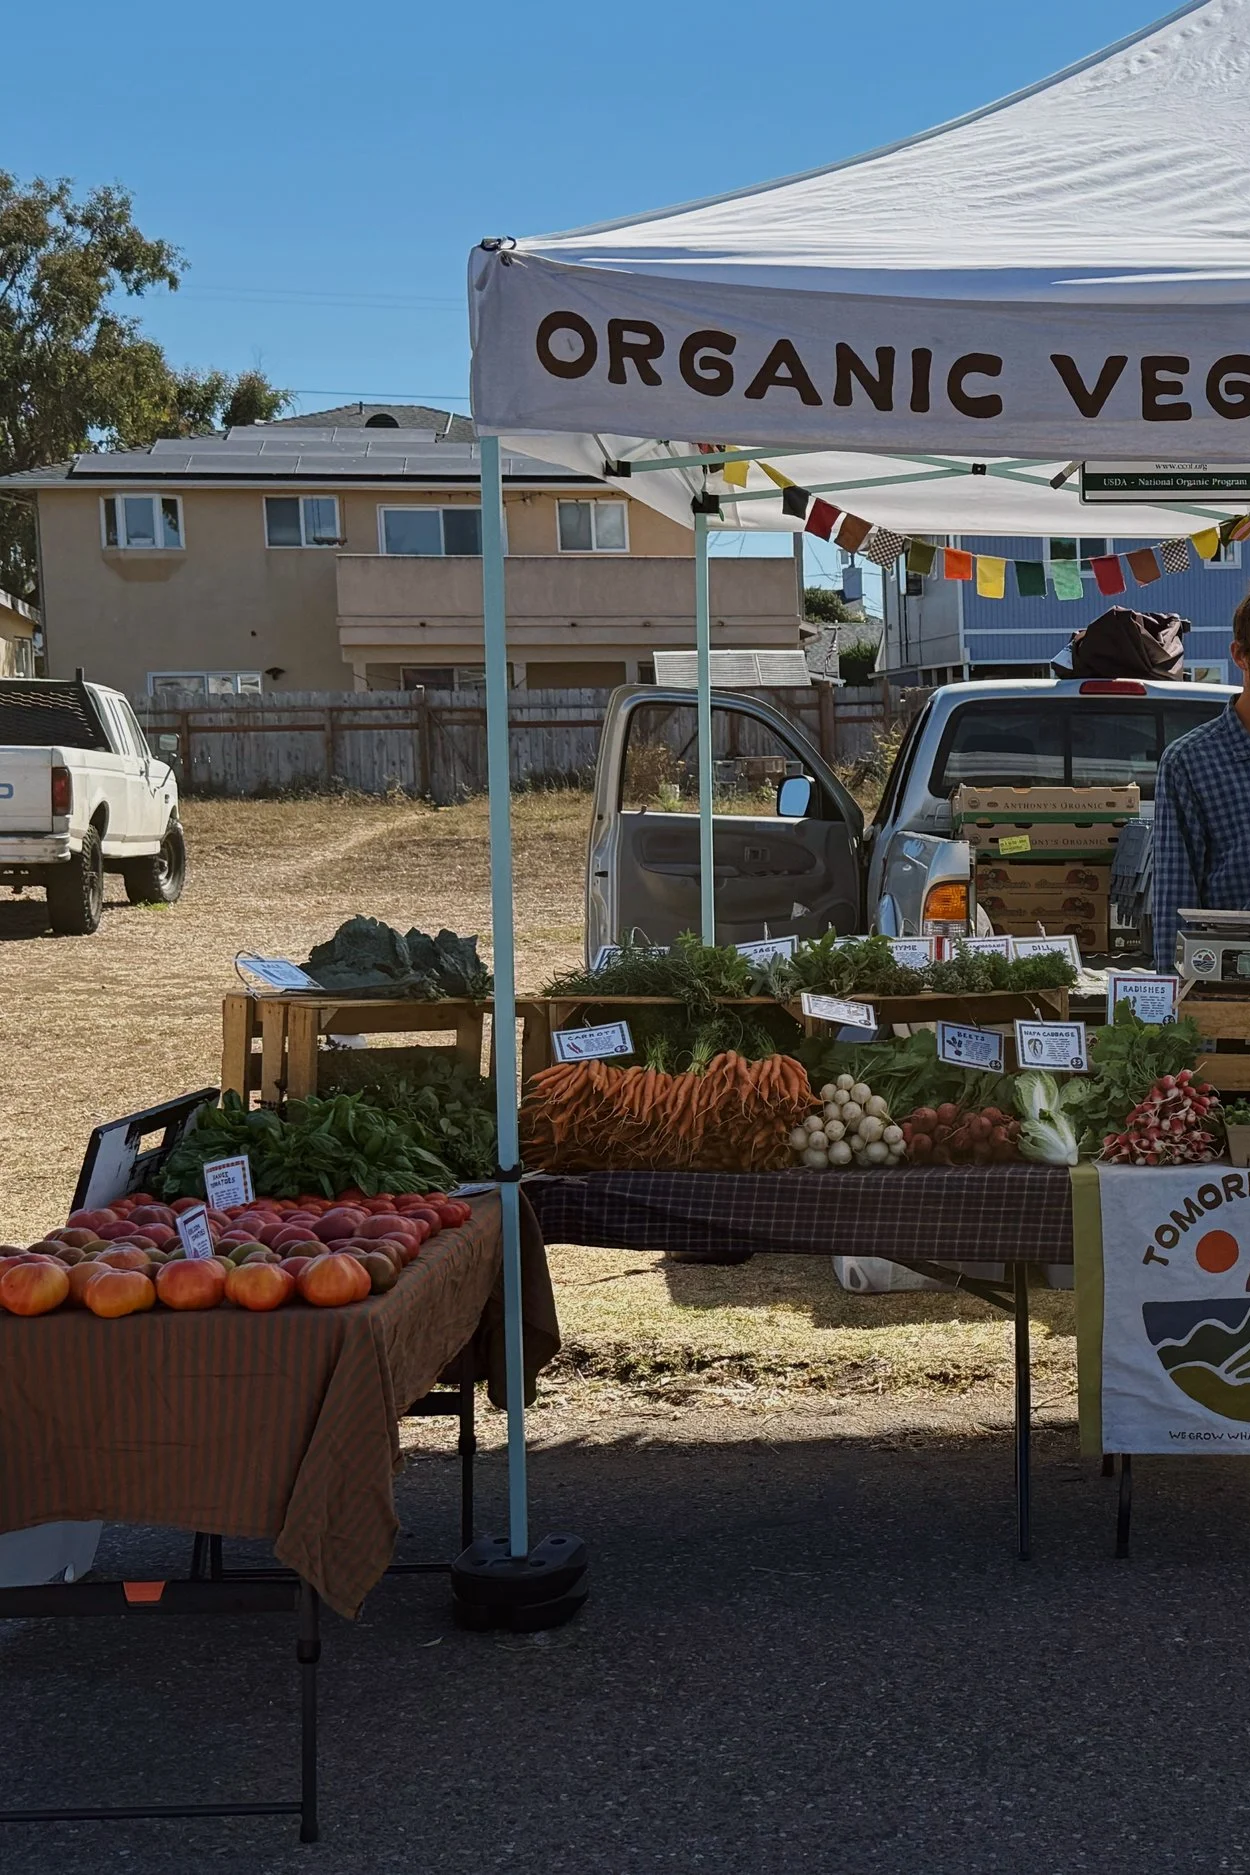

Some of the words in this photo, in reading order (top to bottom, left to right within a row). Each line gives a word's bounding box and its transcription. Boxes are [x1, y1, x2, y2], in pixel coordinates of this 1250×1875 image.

[536, 310, 1003, 419] ORGANIC
[1103, 478, 1127, 486] USDA
[1138, 478, 1174, 486] National
[1176, 478, 1210, 487] Organic
[1212, 478, 1248, 487] Program
[753, 946, 776, 954] SAGE
[1123, 985, 1166, 994] RADISHES
[568, 1030, 616, 1040] CARROTS
[957, 1031, 985, 1041] BEETS
[1169, 1431, 1186, 1440] WE
[1188, 1431, 1224, 1441] GROW
